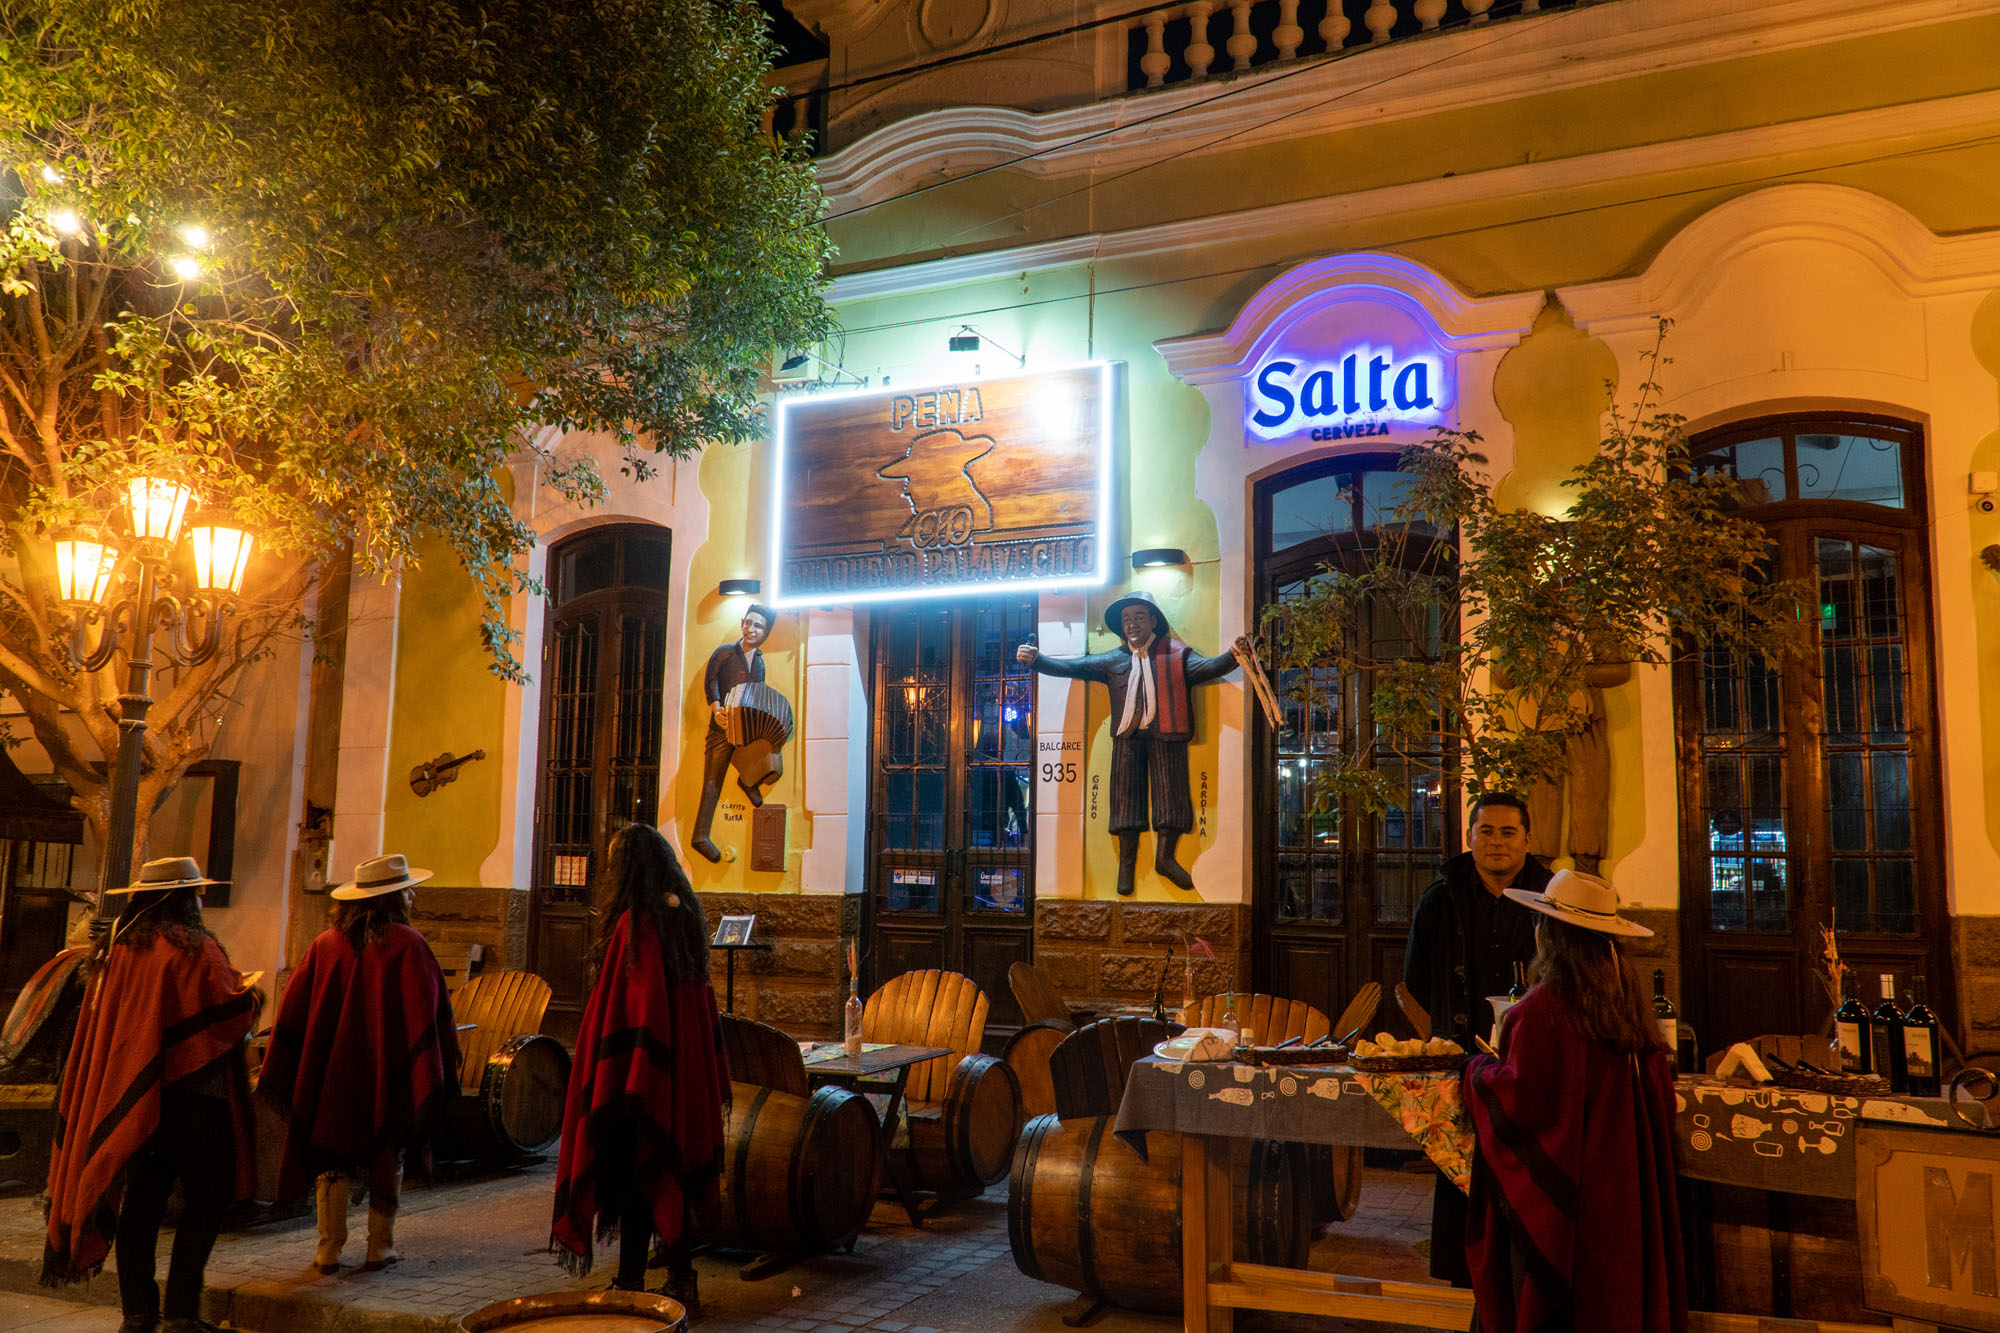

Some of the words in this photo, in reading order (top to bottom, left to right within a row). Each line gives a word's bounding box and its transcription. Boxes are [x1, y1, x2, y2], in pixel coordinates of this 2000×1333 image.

[891, 385, 983, 431] PEÑA
[1253, 353, 1434, 427] Salta
[1311, 423, 1389, 441] CERVEZA
[924, 537, 1096, 584] PALAVECINO
[1040, 741, 1081, 751] BALCARCE
[1042, 763, 1077, 783] 935
[1091, 775, 1099, 819] GAUCHO
[1200, 772, 1208, 837] SARDINA
